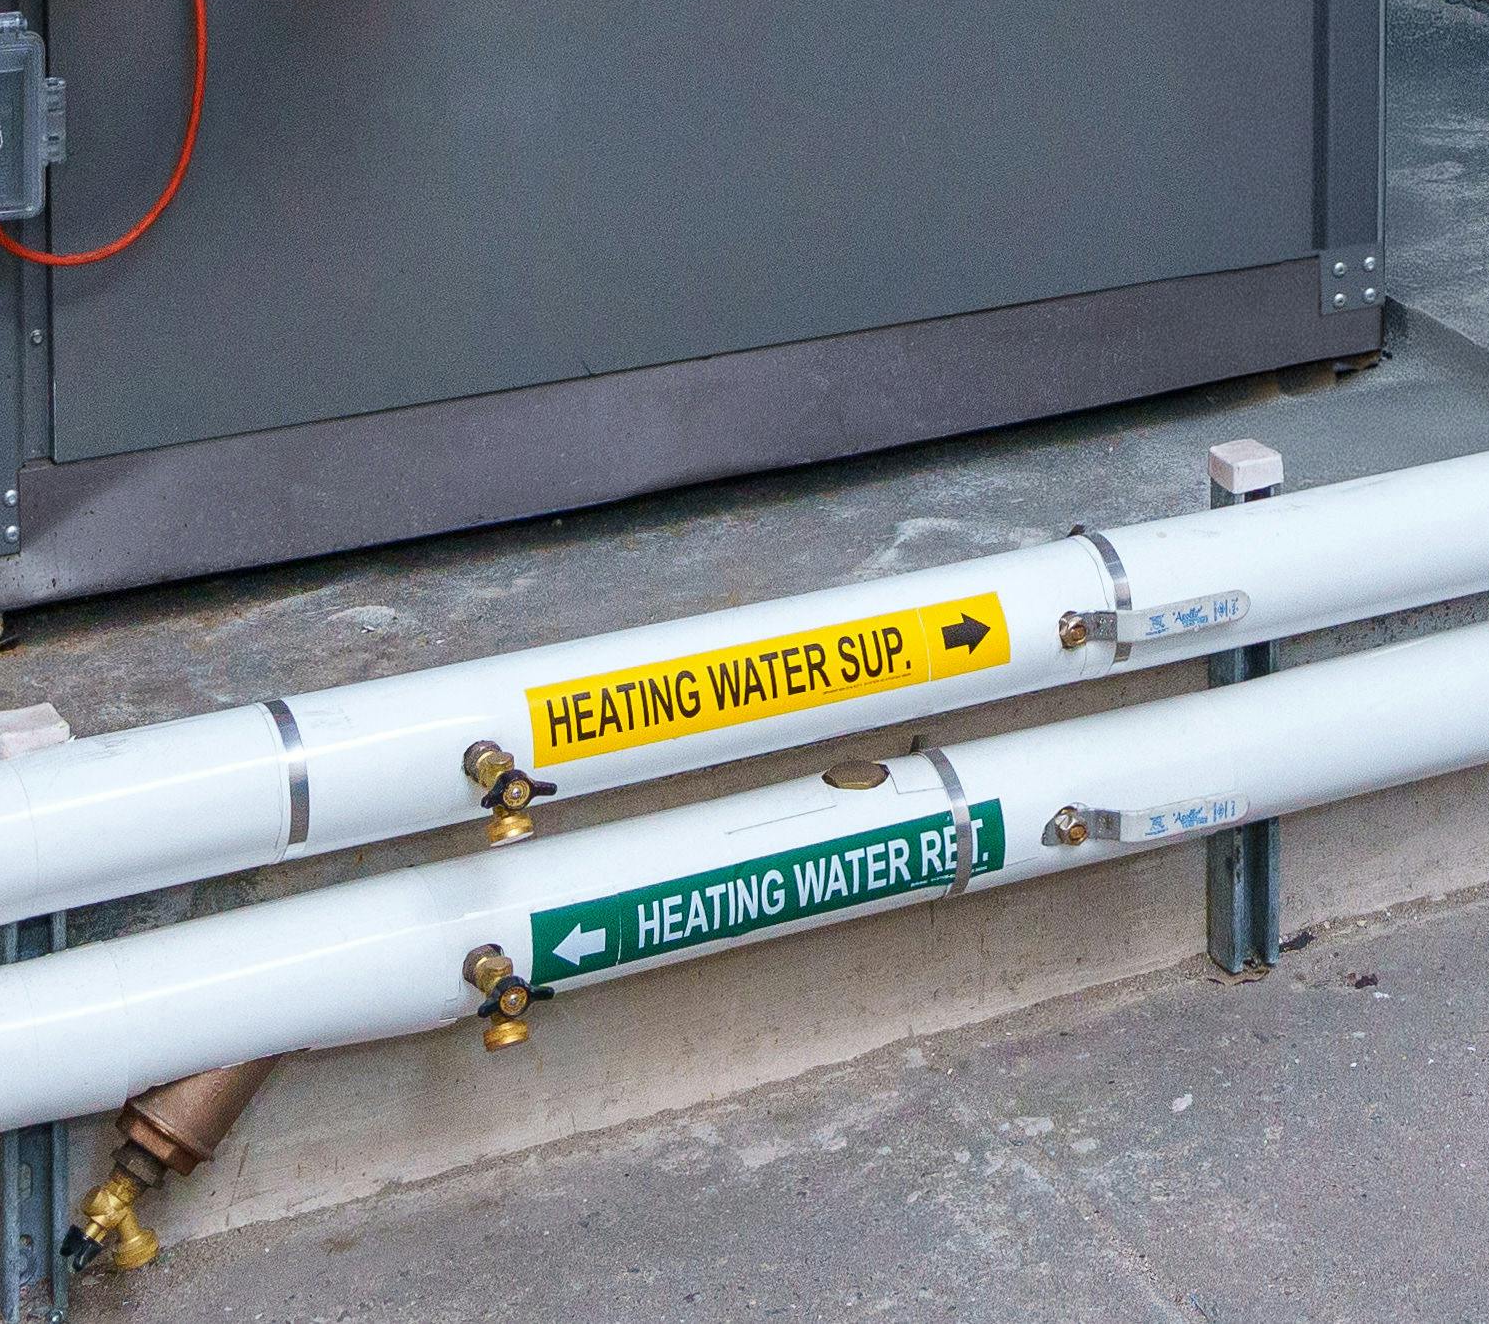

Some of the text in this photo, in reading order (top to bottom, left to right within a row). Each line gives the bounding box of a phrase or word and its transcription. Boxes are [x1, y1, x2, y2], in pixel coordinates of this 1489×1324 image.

[546, 626, 912, 747] HEATING WATER SUP.
[637, 869, 786, 949] HEATING
[793, 837, 912, 908] WATER
